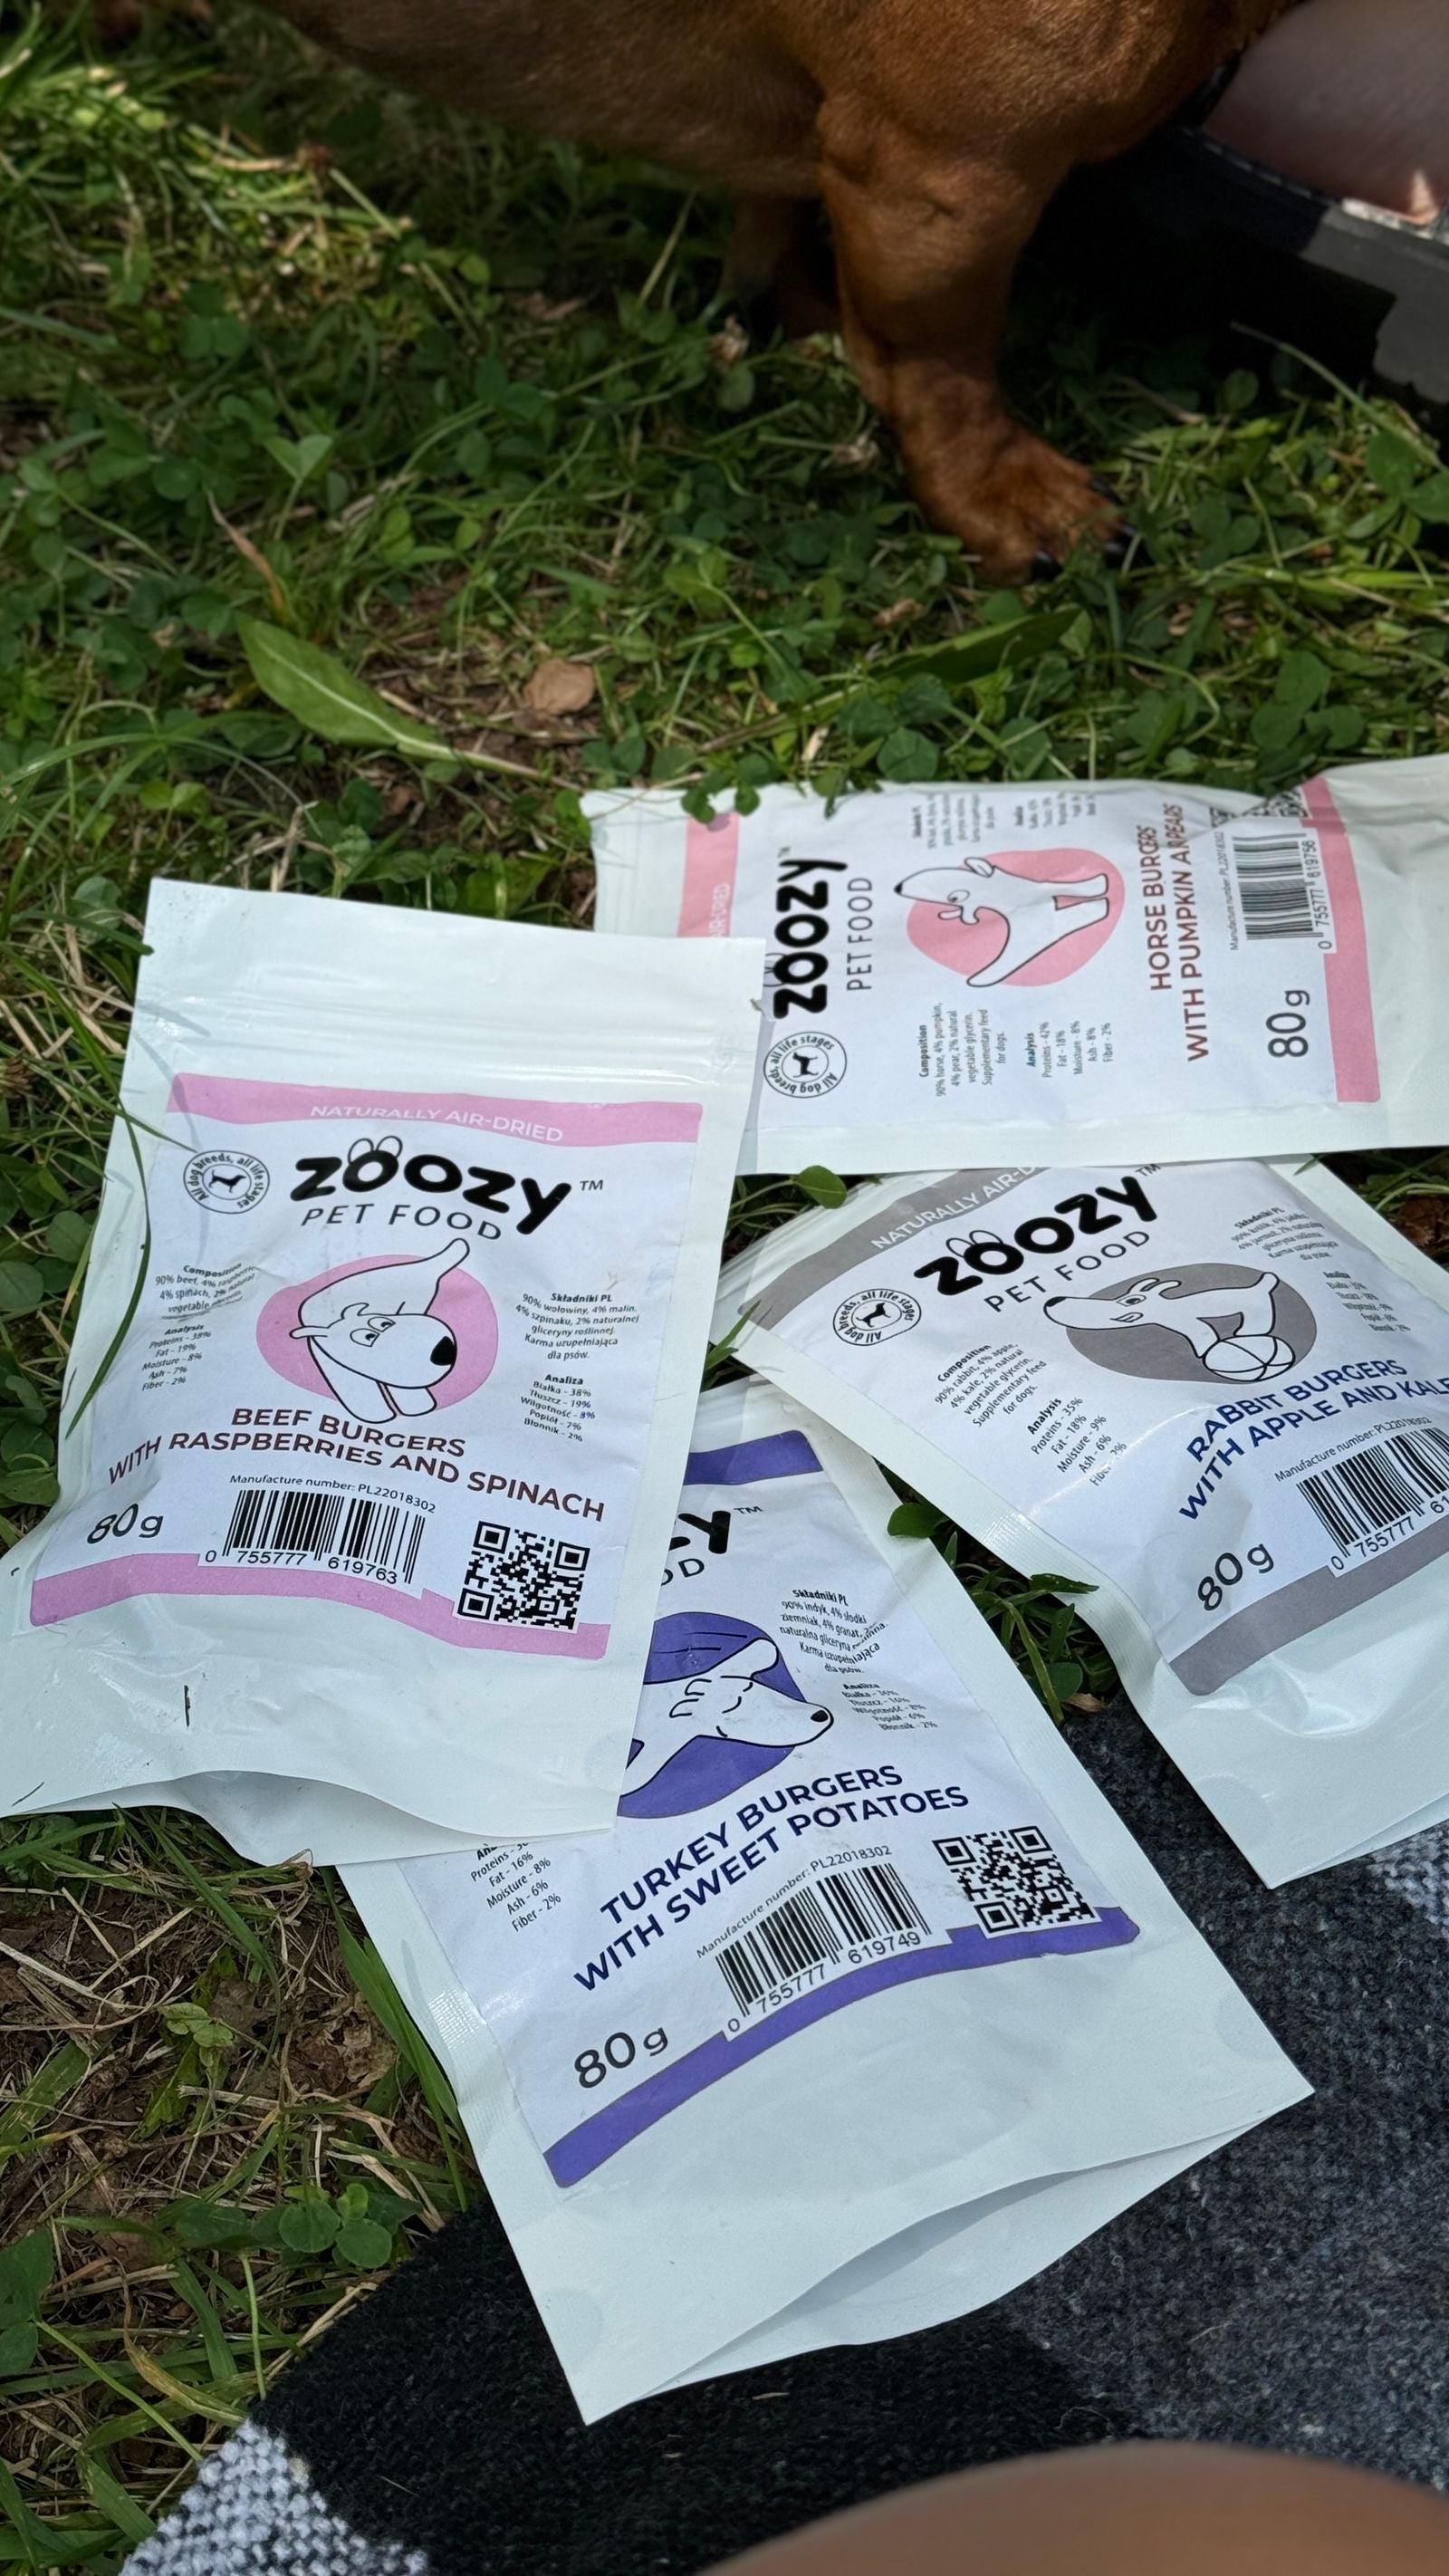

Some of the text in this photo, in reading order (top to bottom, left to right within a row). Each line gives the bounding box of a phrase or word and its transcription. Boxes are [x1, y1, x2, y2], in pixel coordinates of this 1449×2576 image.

[846, 878, 873, 991] PET FOOD
[1172, 870, 1203, 979] PUMPKIN
[1310, 889, 1332, 950] 0 755777
[1144, 904, 1172, 991] HORSE
[800, 1034, 835, 1051] stages
[1183, 988, 1209, 1062] WITH
[770, 1051, 783, 1064] all
[777, 1039, 798, 1053] life
[917, 1024, 931, 1078] Composition
[981, 1027, 994, 1086] Supplementary
[800, 1082, 821, 1094] dog
[310, 1106, 563, 1143] NATURALLY AIR-DRIED
[187, 1168, 202, 1189] dog
[236, 1157, 254, 1168] all
[251, 1164, 264, 1180] life
[190, 1184, 209, 1203] All
[236, 1180, 264, 1209] stages
[302, 1204, 501, 1240] PET FOOD
[870, 1192, 981, 1250] NATURALLY
[984, 1231, 1150, 1312] PET FOOD
[168, 1301, 210, 1313] vegetable
[600, 1293, 612, 1302] PL
[861, 1291, 876, 1301] all
[879, 1291, 899, 1302] life
[897, 1298, 916, 1322] stages
[149, 1335, 184, 1350] Proteins
[164, 1324, 205, 1336] Analysis
[524, 1333, 554, 1348] Karma
[531, 1324, 573, 1338] gliceryny
[844, 1327, 864, 1342] dog
[866, 1331, 882, 1343] All
[141, 1357, 180, 1371] Moisture
[155, 1347, 169, 1358] Fat
[547, 1350, 561, 1360] dla
[937, 1344, 992, 1383] Composition
[141, 1379, 164, 1392] Fiber
[148, 1369, 165, 1380] Ash
[544, 1373, 584, 1385] Analiza
[949, 1395, 965, 1409] 4%
[983, 1366, 997, 1380] 2%
[995, 1349, 1024, 1369] natural
[935, 1387, 955, 1405] 90%
[964, 1378, 1000, 1416] vegetable
[972, 1360, 1048, 1428] Supplementary feed
[1003, 1400, 1018, 1416] for
[1185, 1359, 1408, 1463] RABBIT BURGERS
[231, 1408, 466, 1456] BEEF BURGERS
[1027, 1398, 1062, 1436] Analysis
[1031, 1397, 1084, 1456] Proteins 35%
[1051, 1413, 1088, 1456] Fat 18%
[1057, 1415, 1107, 1474] Moisture 9%
[1078, 1434, 1112, 1474] Ash 6%
[1178, 1437, 1245, 1521] WITH
[1247, 1399, 1342, 1448] APPLE
[1340, 1384, 1397, 1408] AND
[109, 1432, 605, 1523] WITH RASPBERRIES AND SPINACH
[1274, 1447, 1336, 1483] Manufacture
[229, 1474, 437, 1514] Manufacture number: PL22018302
[1329, 1515, 1415, 1571] 0 755777
[205, 1550, 398, 1585] 0 755777 619763
[799, 1641, 824, 1658] Karma
[600, 1764, 903, 1925] TURKEY BURGERS
[471, 1850, 509, 1882] Proteins
[486, 1857, 552, 1908] Moisture 8%
[488, 1871, 506, 1888] Fat
[511, 1850, 534, 1871] 16%
[506, 1879, 549, 1916] Ash 6%
[573, 1786, 969, 1992] WITH SWEET POTATOES
[696, 1904, 764, 1959] Manufacture
[809, 1844, 893, 1872] PL22018302
[512, 1893, 561, 1932] Fiber 2%
[727, 1931, 921, 2033] 0 755777 619749
